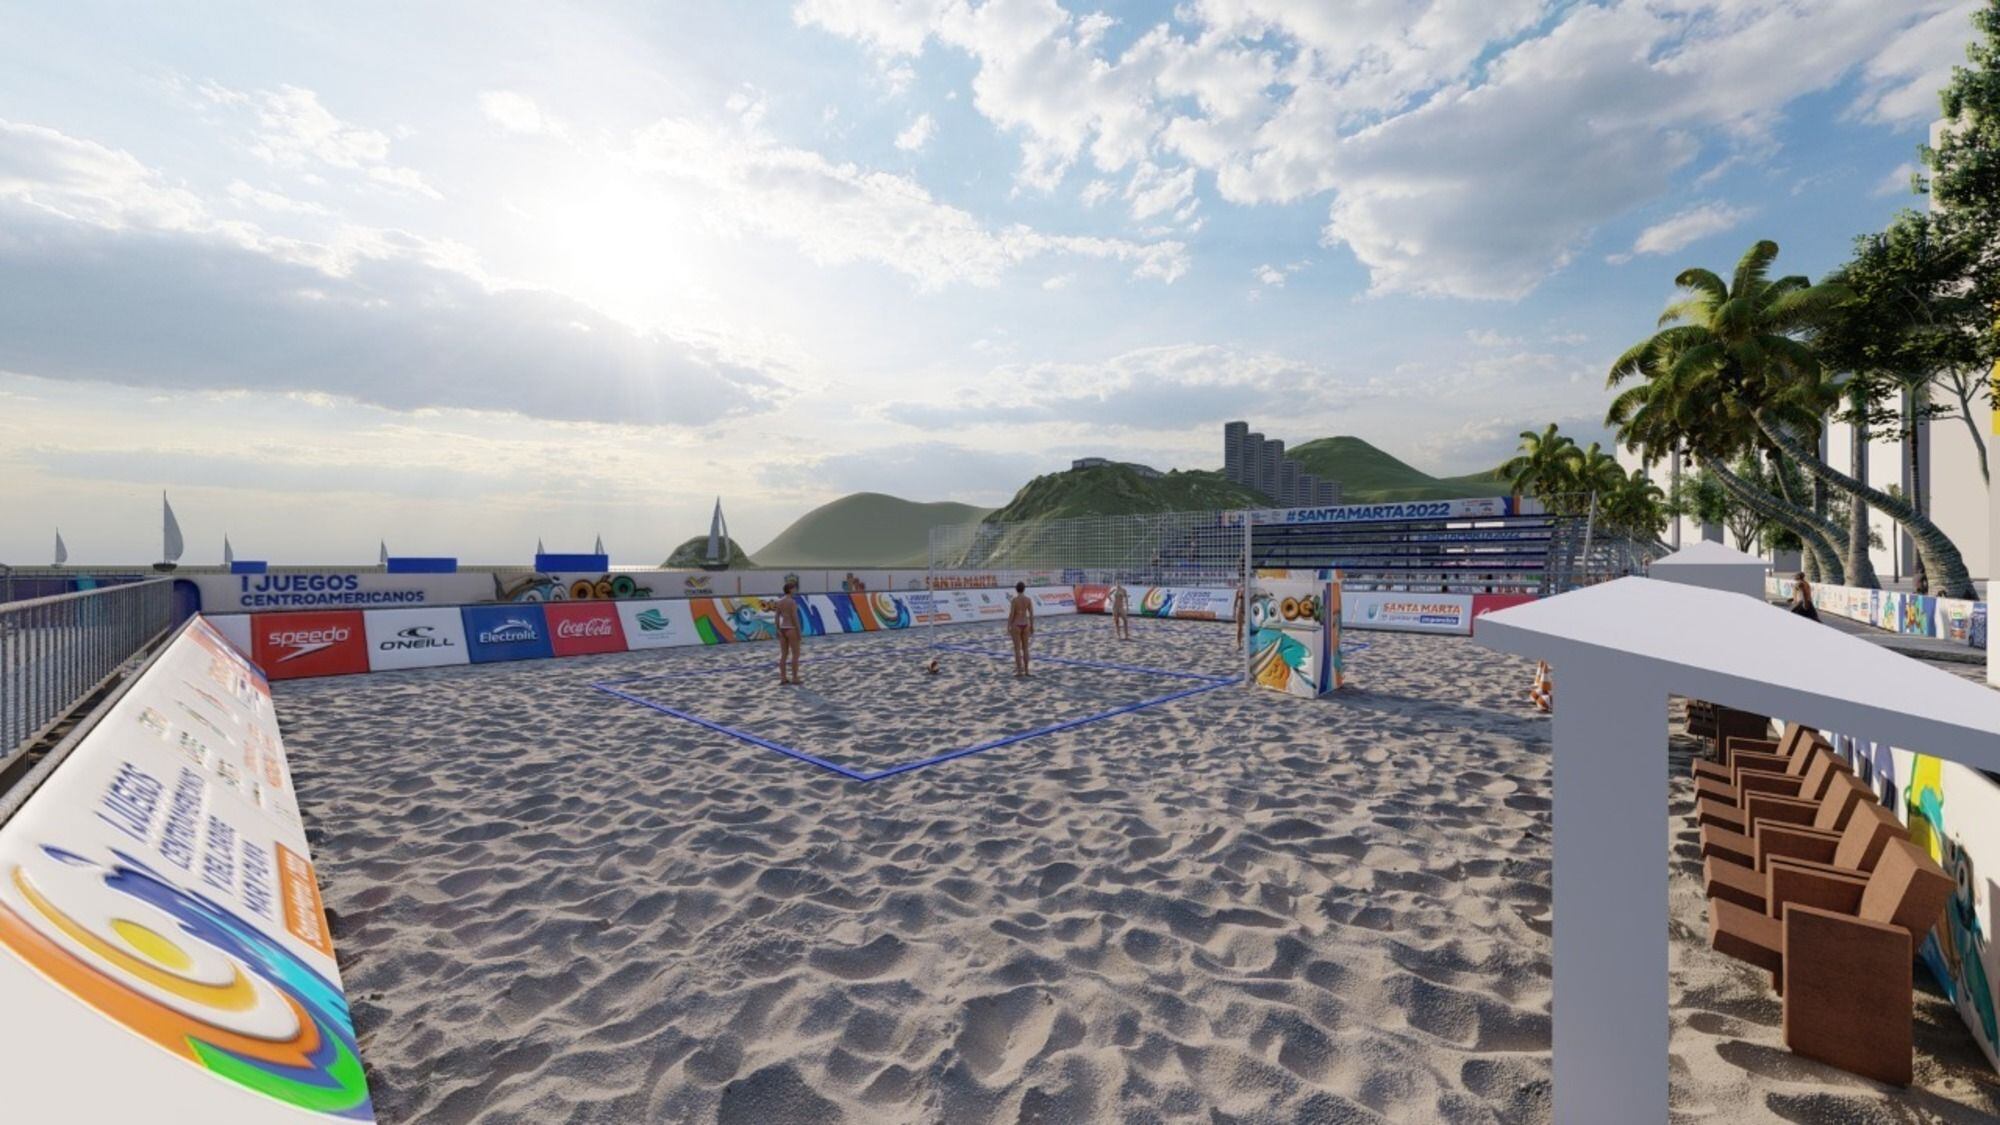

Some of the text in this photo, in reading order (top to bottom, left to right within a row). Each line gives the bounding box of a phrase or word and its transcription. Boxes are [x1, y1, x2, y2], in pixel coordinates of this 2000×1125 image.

[1286, 502, 1450, 522] #SANTAMARTA2022
[240, 574, 360, 593] I JUEGOS
[240, 591, 425, 607] CENTROAMERICANOS
[1383, 602, 1462, 614] SANTA MARTA
[268, 626, 350, 647] speedo
[479, 630, 539, 644] Electrolit
[557, 617, 614, 639] Coca-Cola
[98, 760, 165, 836] JUEGOS
